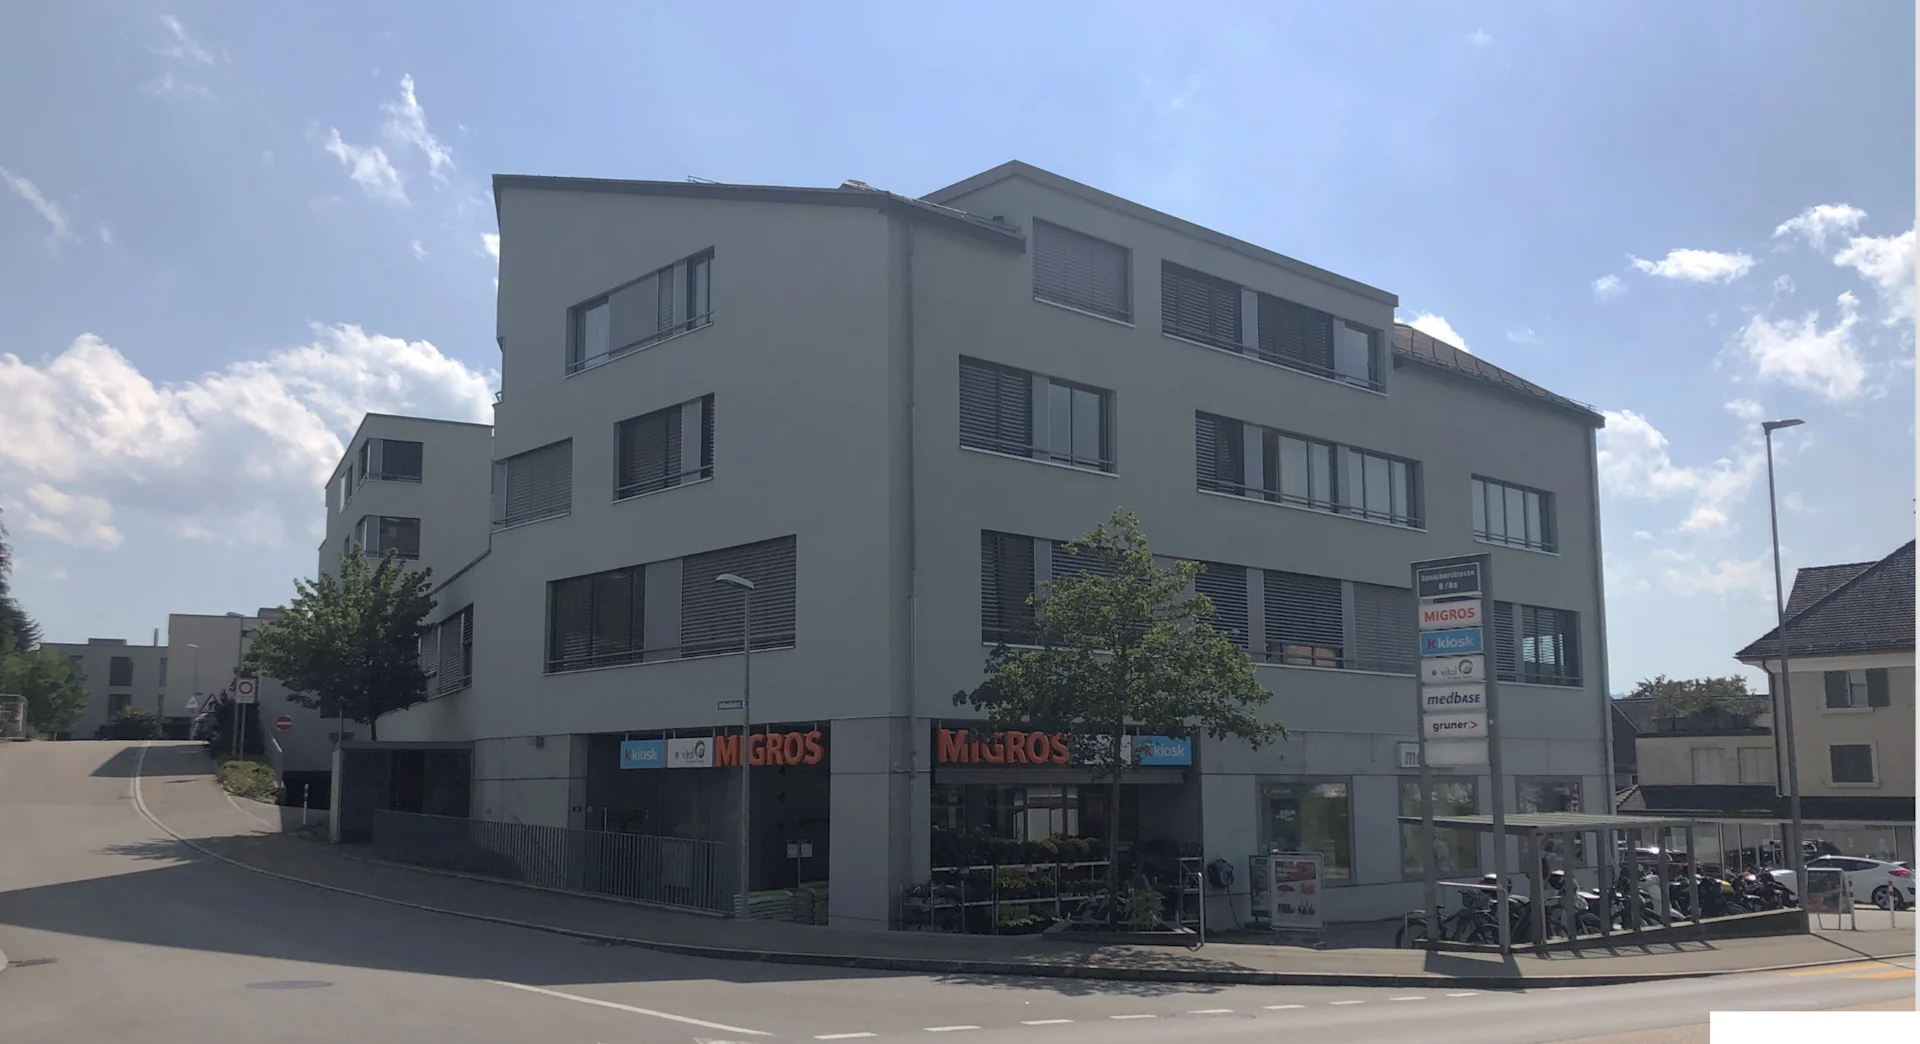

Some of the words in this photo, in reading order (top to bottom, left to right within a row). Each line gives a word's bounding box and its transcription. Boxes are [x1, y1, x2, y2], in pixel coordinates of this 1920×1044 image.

[1424, 607, 1475, 622] MIGROS
[1437, 635, 1475, 649] kiosk
[1432, 721, 1468, 733] gruner
[715, 731, 824, 767] MIGROS
[937, 729, 1070, 764] MIGROS
[1153, 743, 1185, 757] kiosk
[632, 747, 658, 761] kiosk
